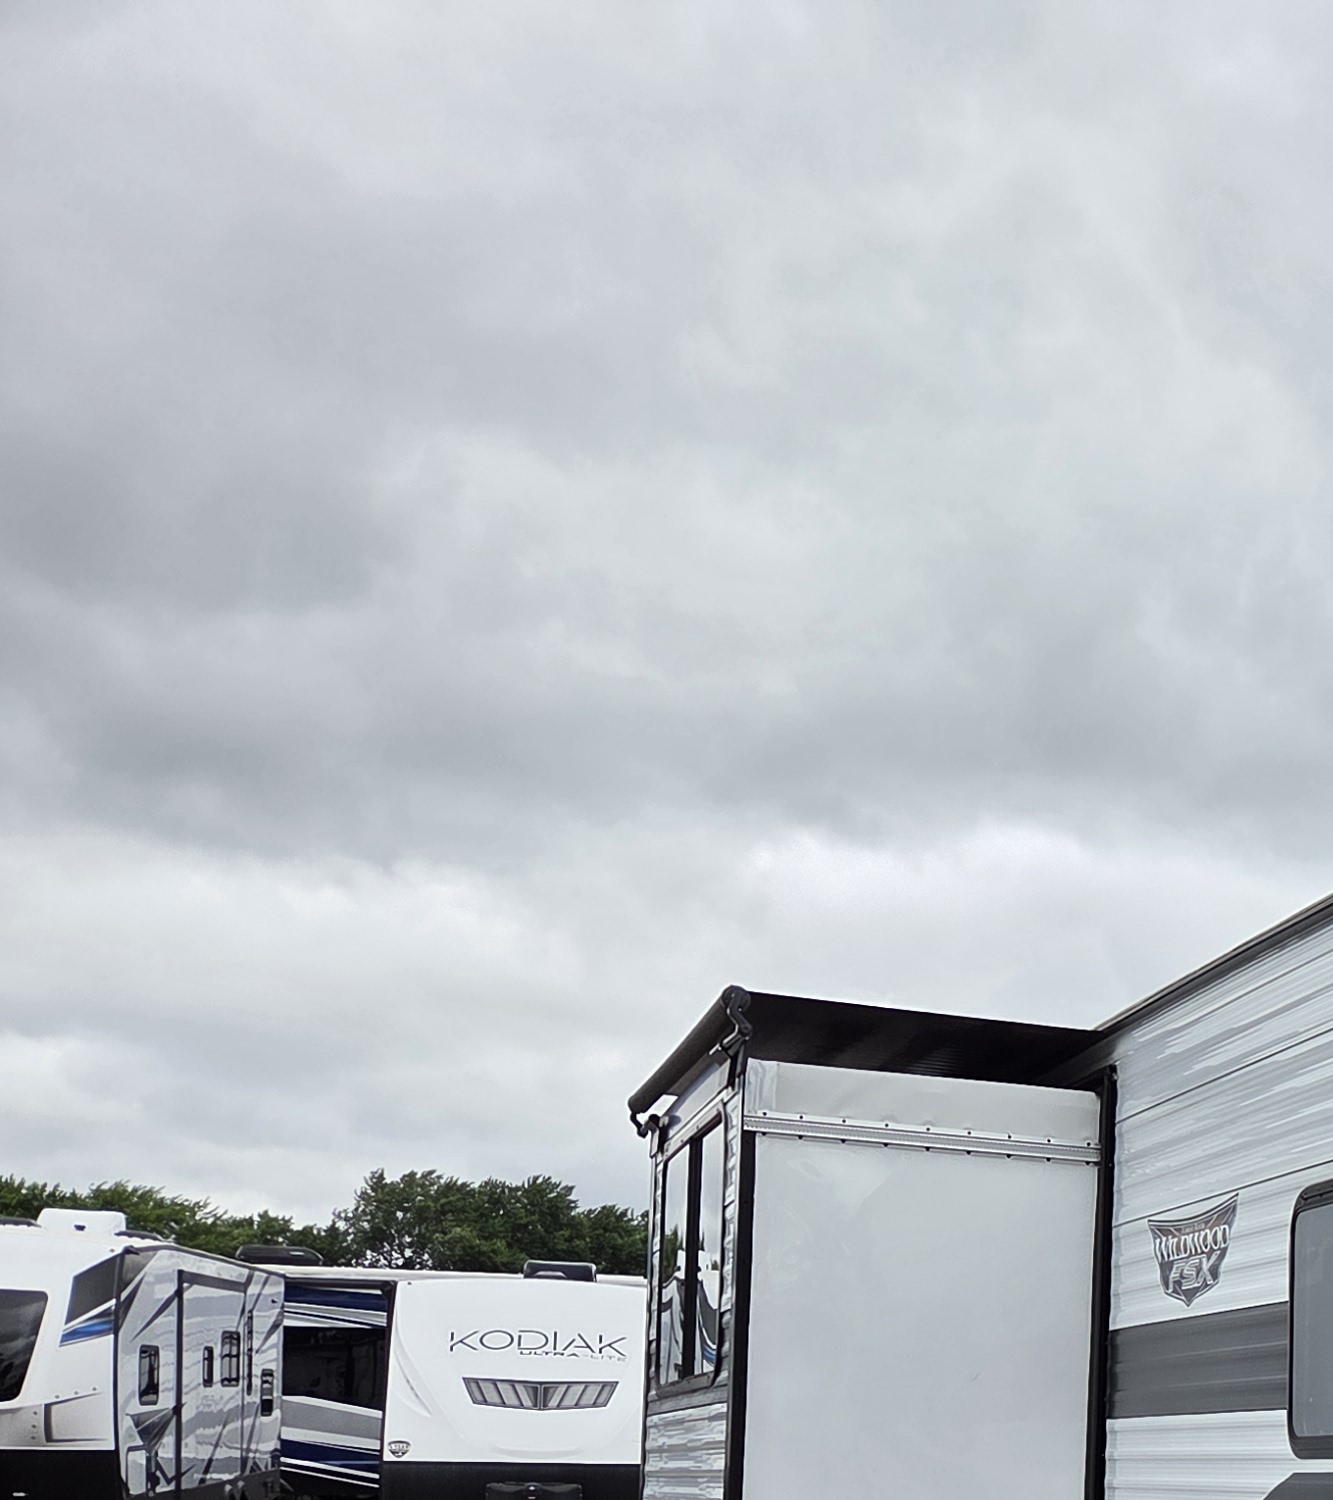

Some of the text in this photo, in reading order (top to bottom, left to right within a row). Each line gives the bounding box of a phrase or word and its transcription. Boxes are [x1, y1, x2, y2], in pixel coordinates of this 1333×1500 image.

[1154, 1224, 1231, 1263] WILDWOOD
[1167, 1250, 1221, 1293] FSX
[449, 1329, 627, 1358] KODIAK
